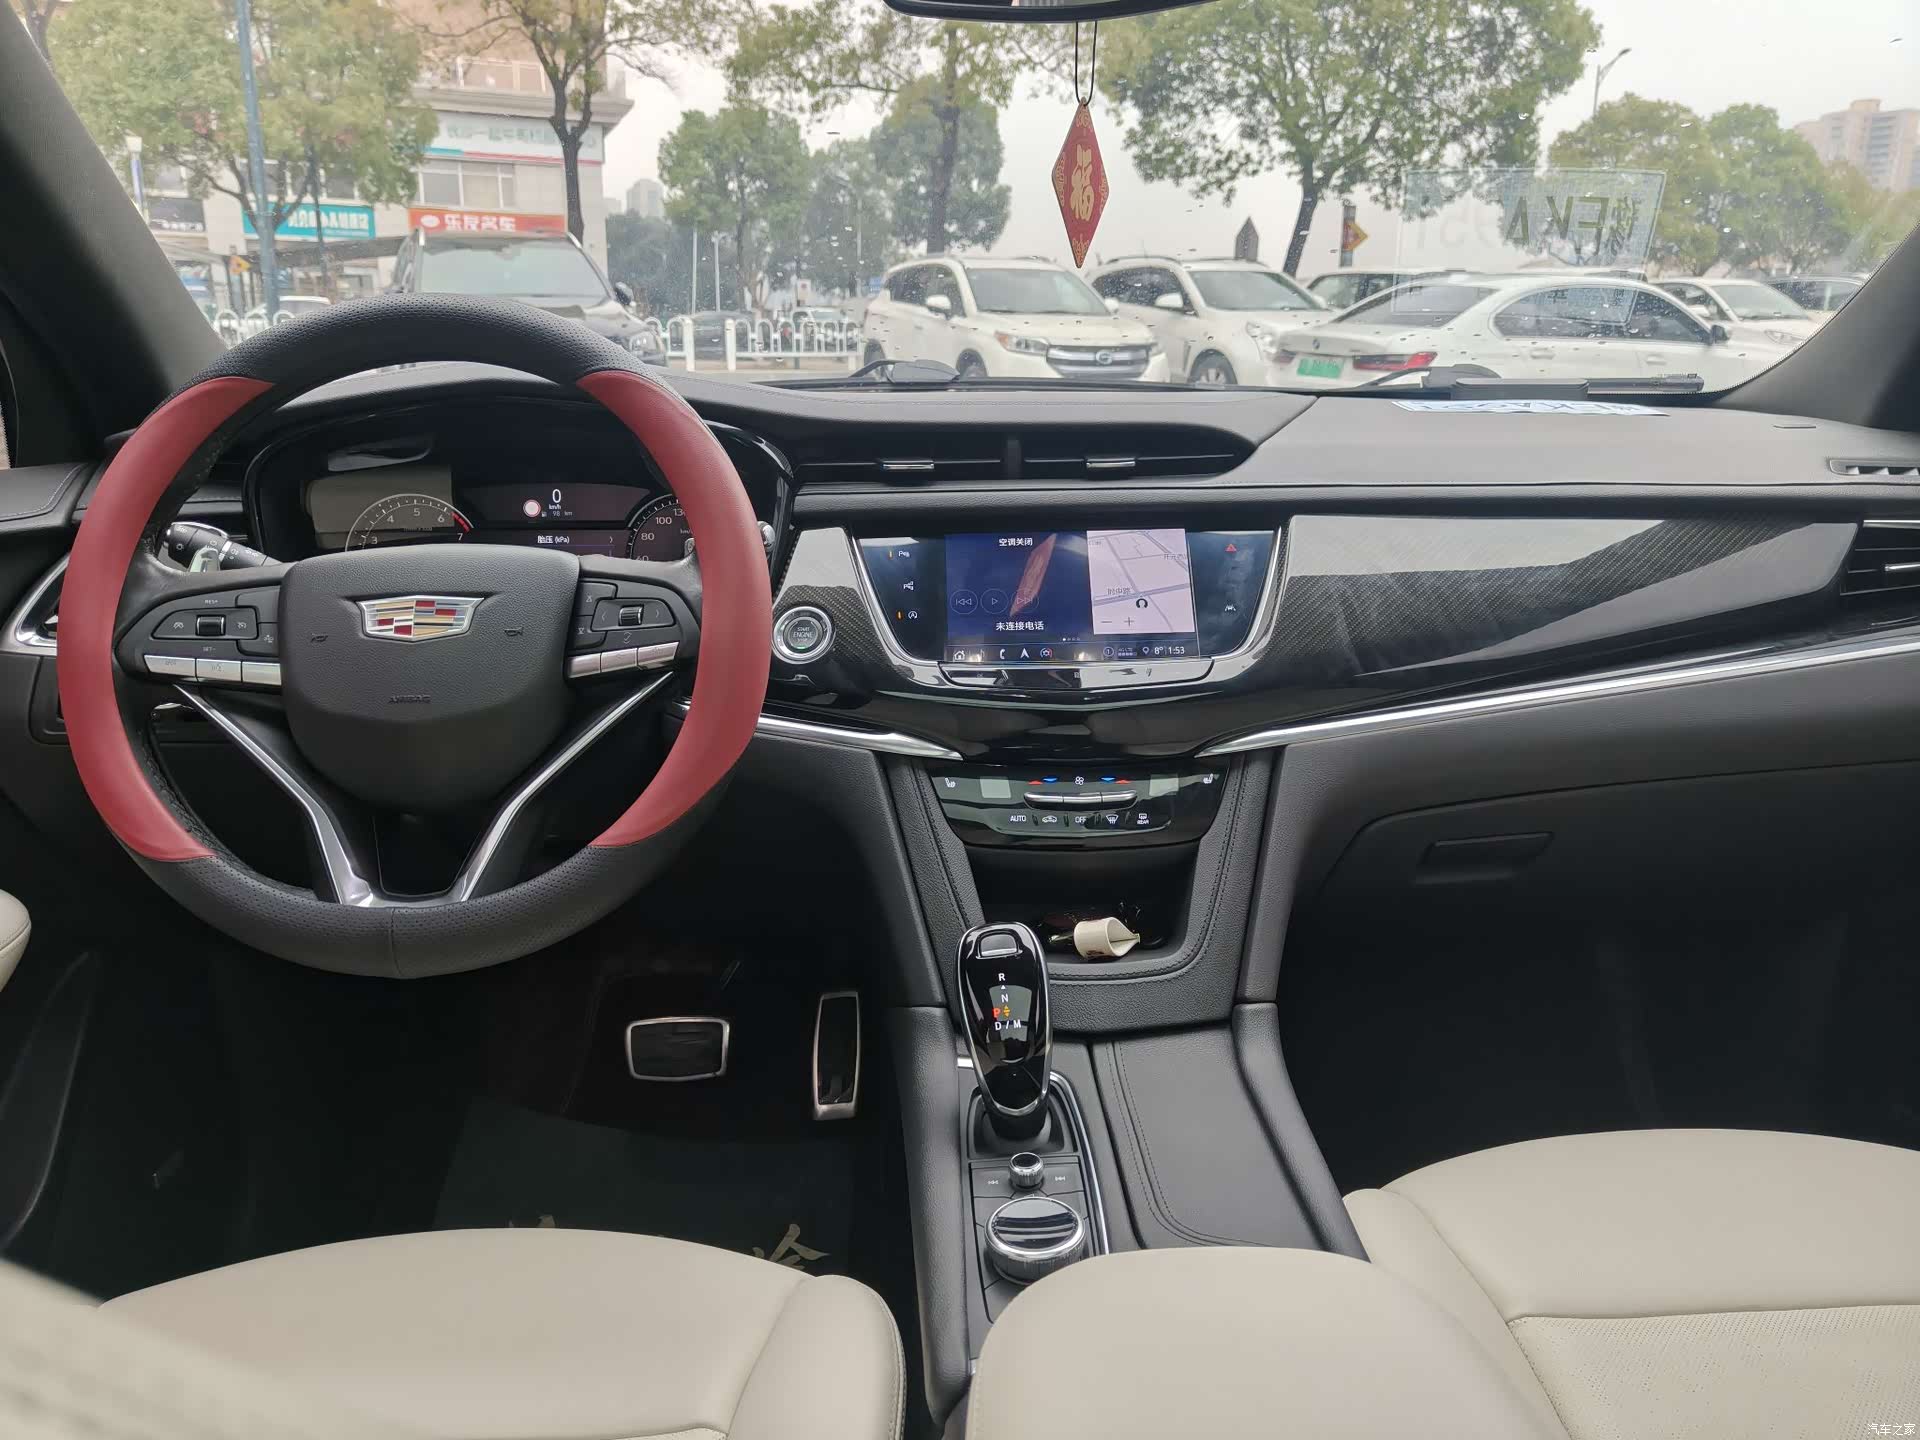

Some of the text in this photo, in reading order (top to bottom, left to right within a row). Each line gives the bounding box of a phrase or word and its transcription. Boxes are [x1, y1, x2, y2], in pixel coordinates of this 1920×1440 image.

[552, 488, 562, 503] 0
[413, 507, 421, 517] 5
[386, 514, 395, 523] 4
[437, 514, 445, 523] 6
[655, 517, 673, 525] 100
[371, 536, 378, 545] 3
[457, 532, 464, 541] 7
[641, 532, 655, 541] 80
[998, 537, 1033, 547] 空调关闭
[995, 620, 1045, 631] 未连接电话
[1168, 646, 1185, 655] 1:53
[1010, 815, 1027, 823] AUTO
[1075, 816, 1087, 824] OFF
[998, 972, 1006, 982] R
[1001, 993, 1009, 1003] N
[993, 1007, 1001, 1018] P
[994, 1021, 1002, 1031] D
[1013, 1018, 1022, 1029] M
